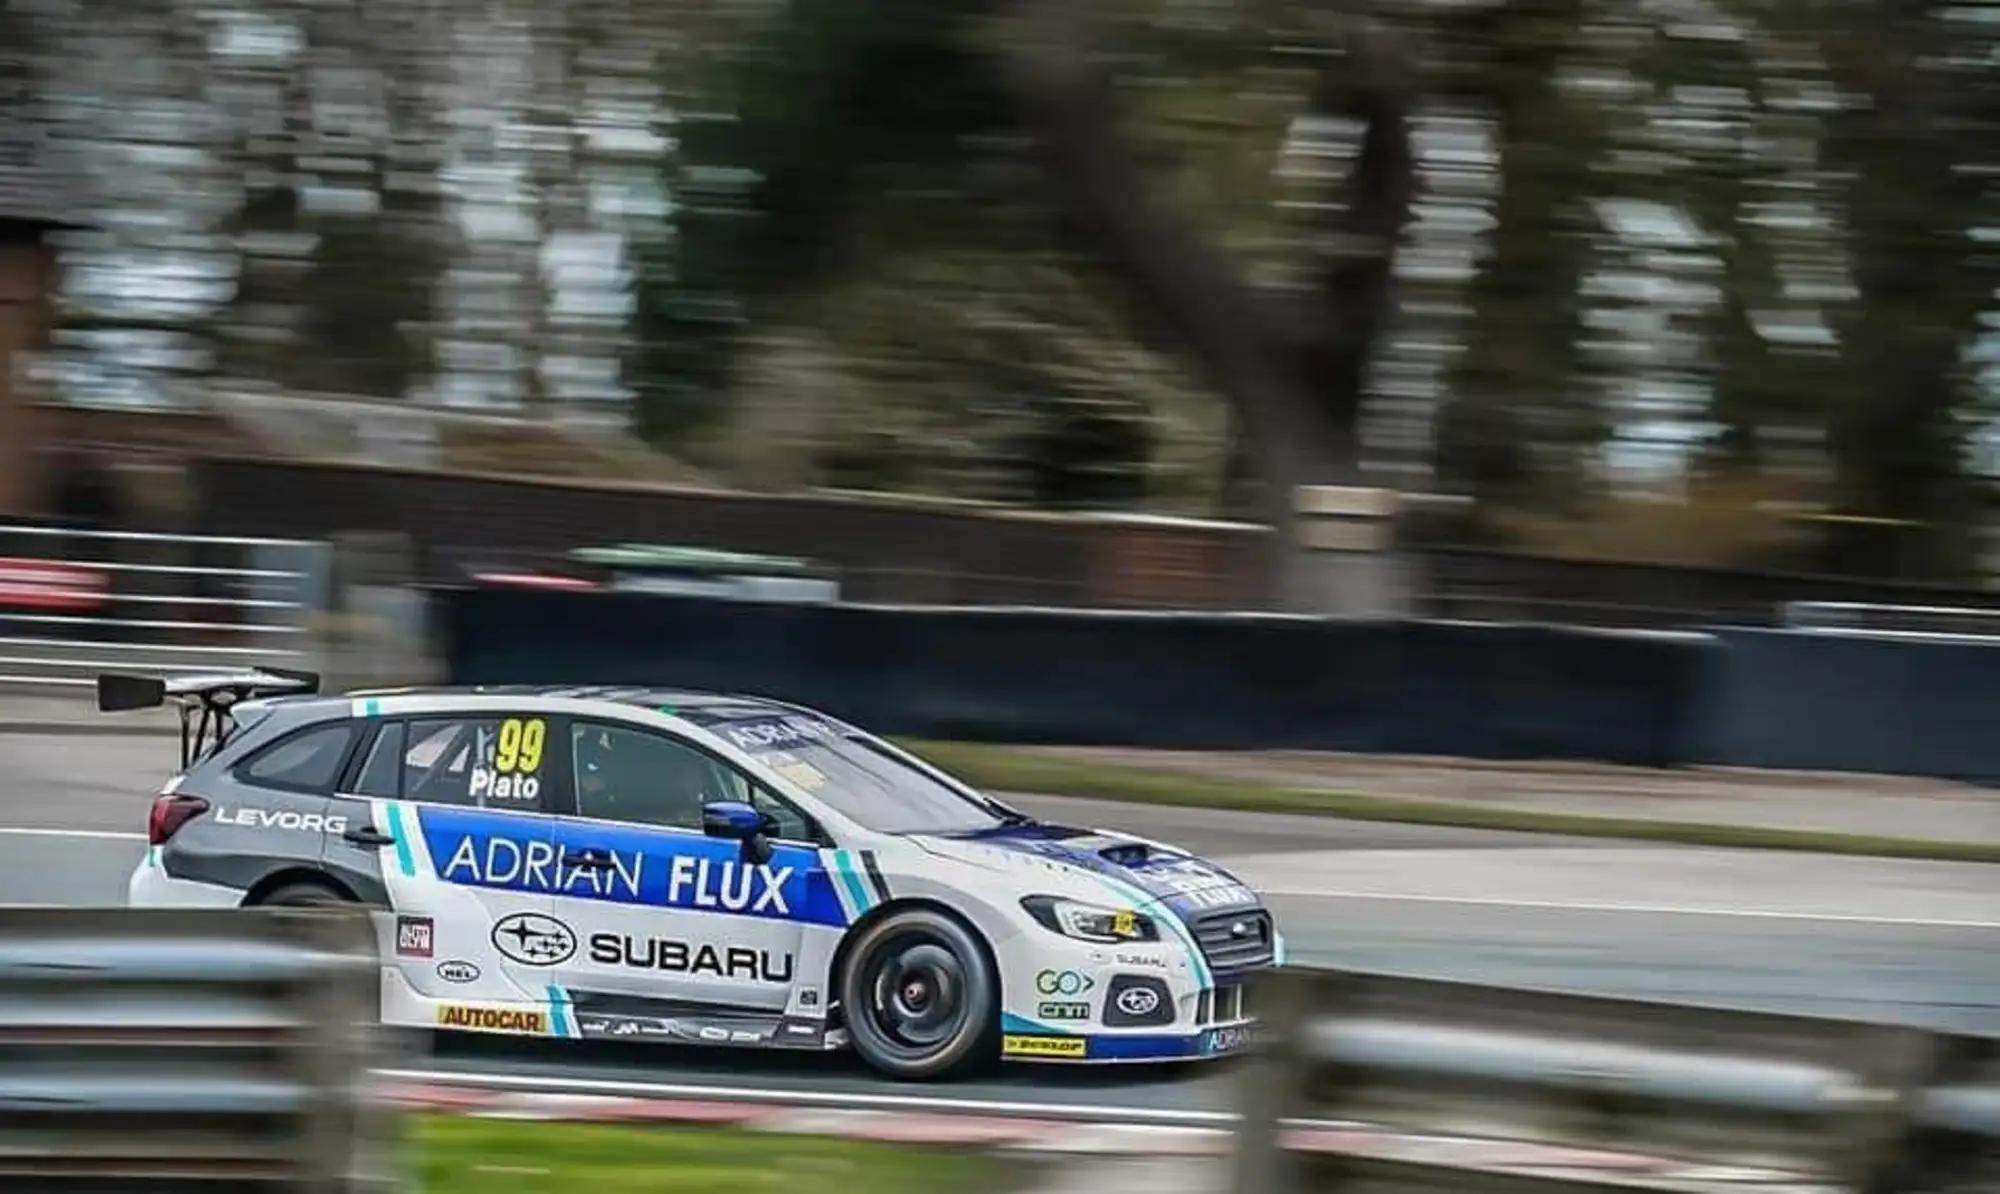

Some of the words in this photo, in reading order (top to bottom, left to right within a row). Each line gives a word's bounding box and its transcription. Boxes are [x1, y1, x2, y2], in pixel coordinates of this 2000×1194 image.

[496, 719, 546, 773] 99
[468, 768, 539, 800] Plato
[214, 805, 348, 834] LEVORG
[444, 836, 641, 897] ADRIAN
[668, 855, 794, 914] FLUX
[589, 933, 793, 982] SUBARU
[443, 1006, 540, 1031] AUTOCAR
